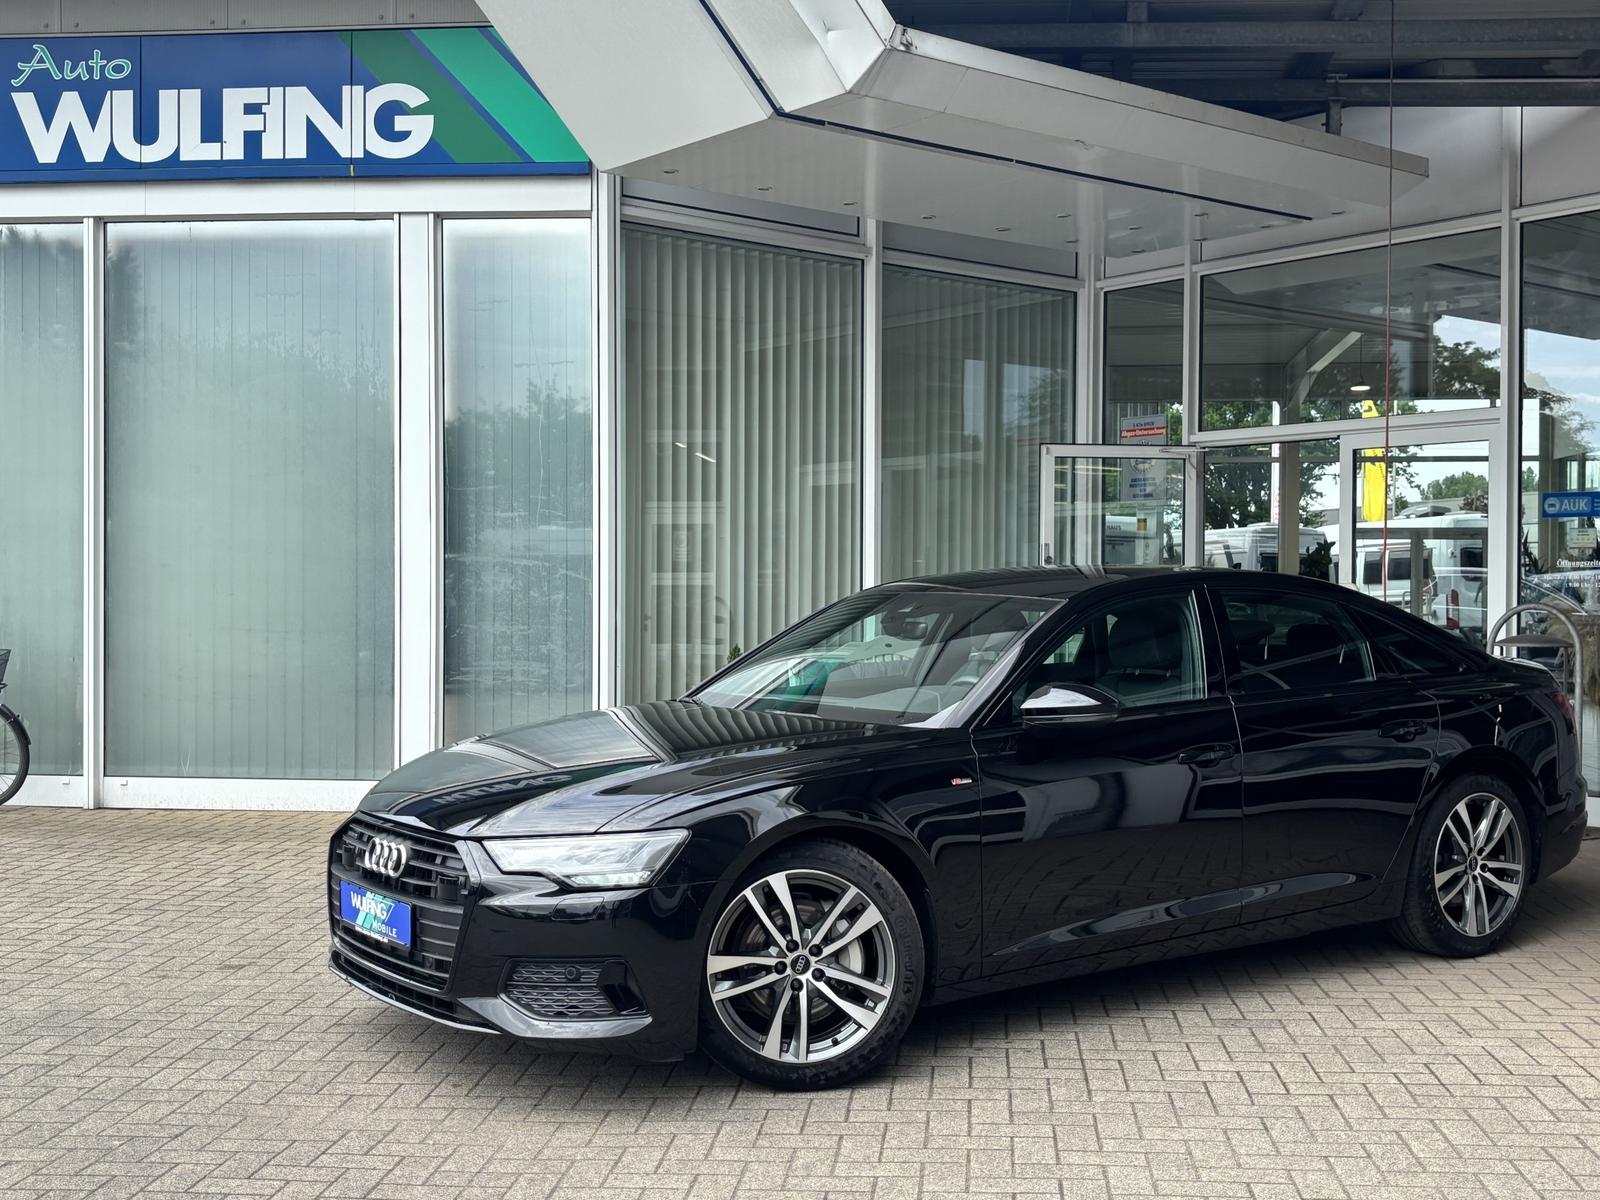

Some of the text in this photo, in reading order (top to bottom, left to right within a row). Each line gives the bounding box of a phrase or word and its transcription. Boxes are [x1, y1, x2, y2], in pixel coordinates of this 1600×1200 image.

[10, 43, 132, 88] Auto
[11, 82, 435, 164] WULFING
[1561, 498, 1588, 511] AUK
